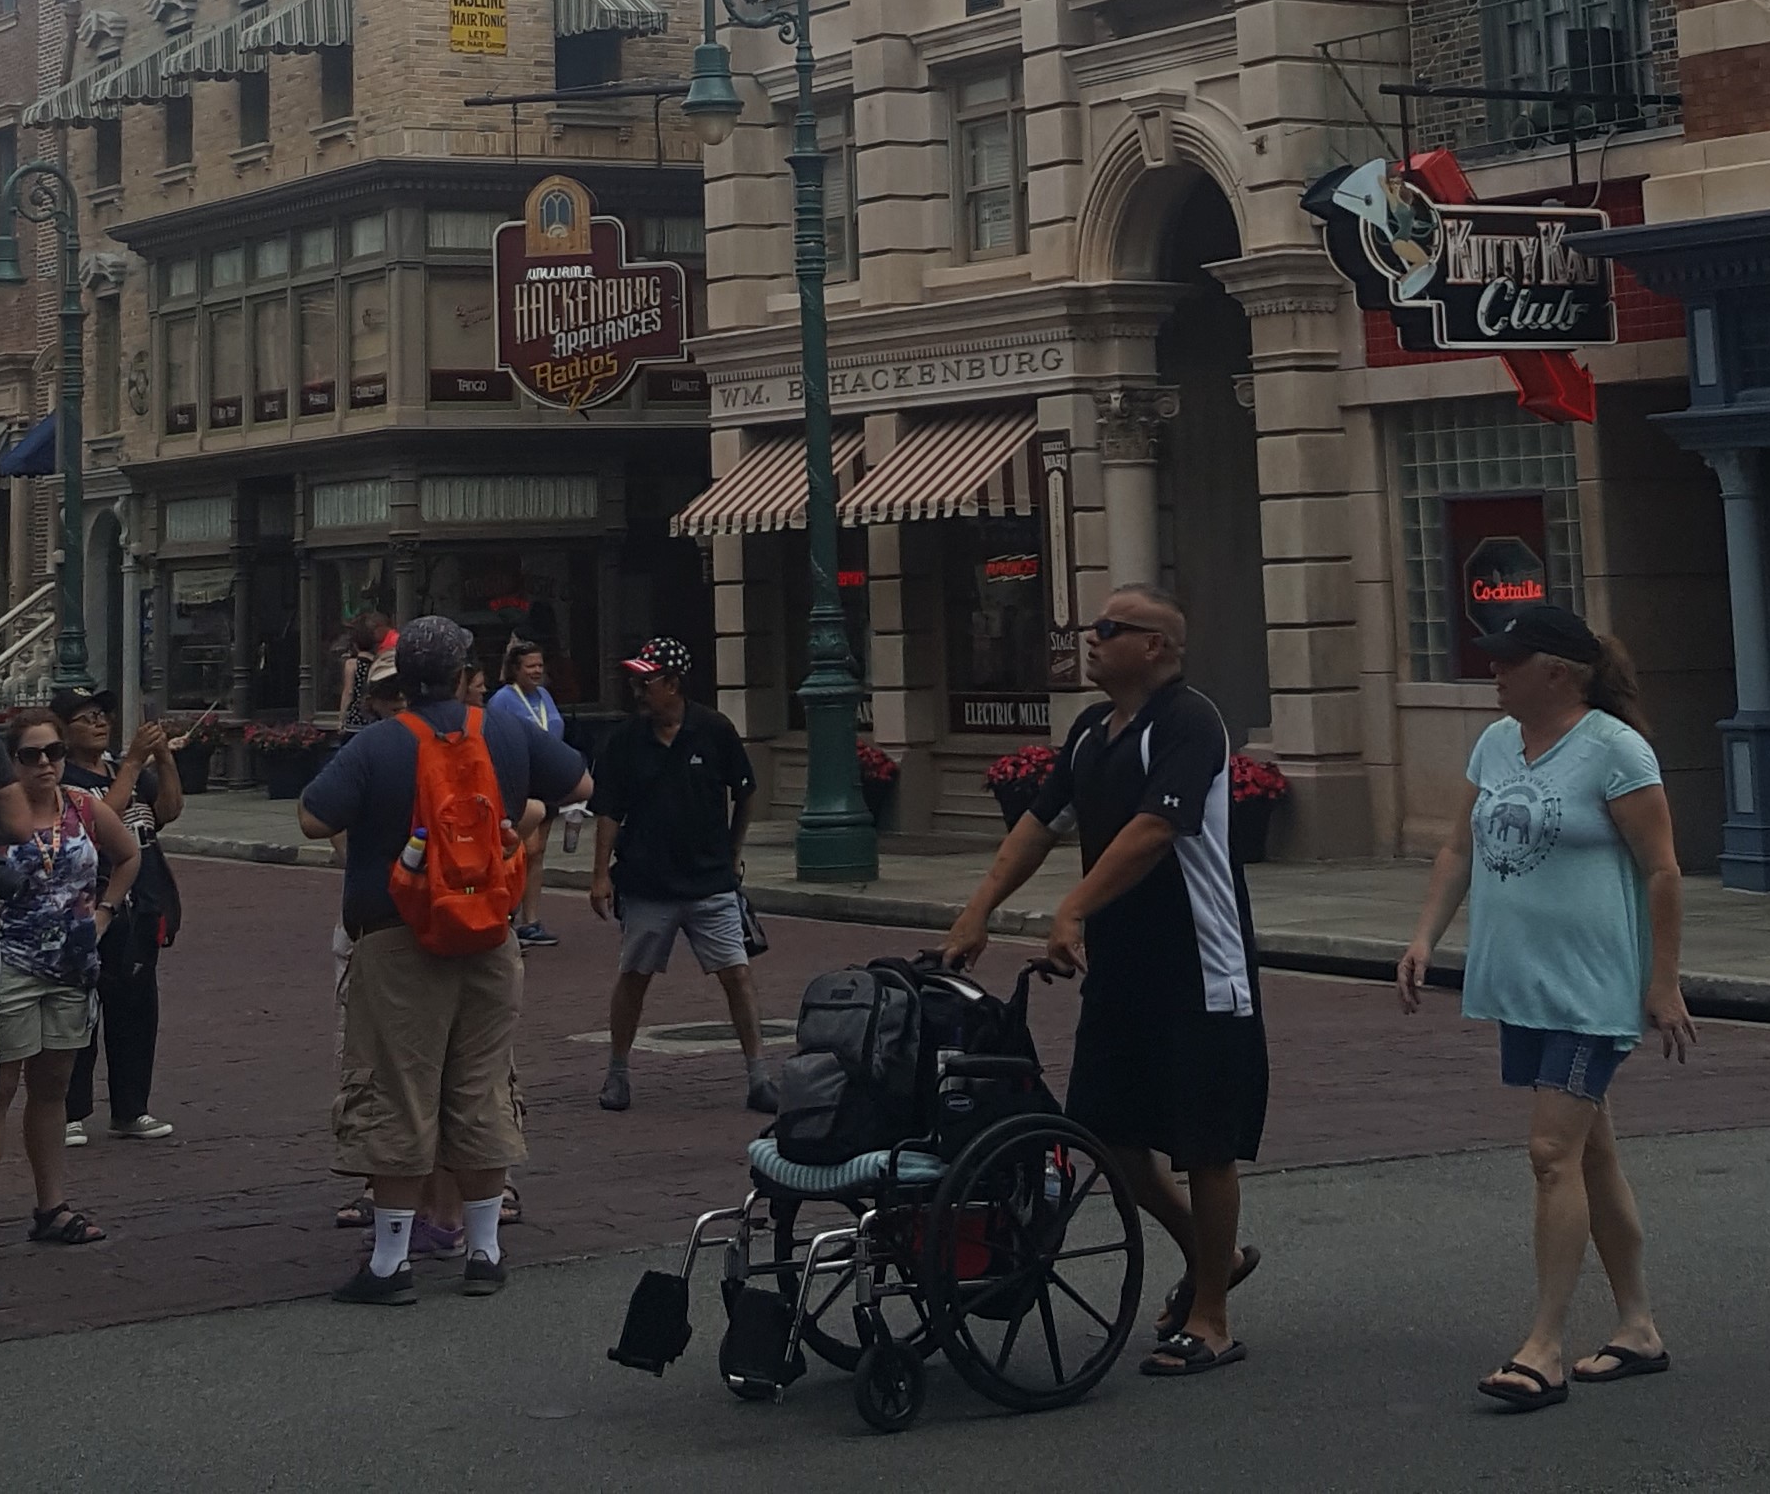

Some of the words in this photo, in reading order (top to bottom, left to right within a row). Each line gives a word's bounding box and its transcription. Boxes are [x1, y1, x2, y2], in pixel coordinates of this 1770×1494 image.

[452, 11, 478, 26] HAIR
[478, 12, 507, 28] TONIC
[514, 276, 662, 344] HACKENBURG
[1477, 276, 1589, 337] Club
[554, 307, 661, 358] APPLIANCES
[456, 377, 488, 393] TANGO
[530, 351, 618, 393] Radios
[719, 384, 771, 408] WM.
[829, 347, 1065, 396] HACKENBURG
[1472, 579, 1545, 602] Cocktails
[1051, 631, 1075, 650] STAGE
[964, 702, 1015, 725] ELECTRIC
[1018, 702, 1050, 726] MIXE
